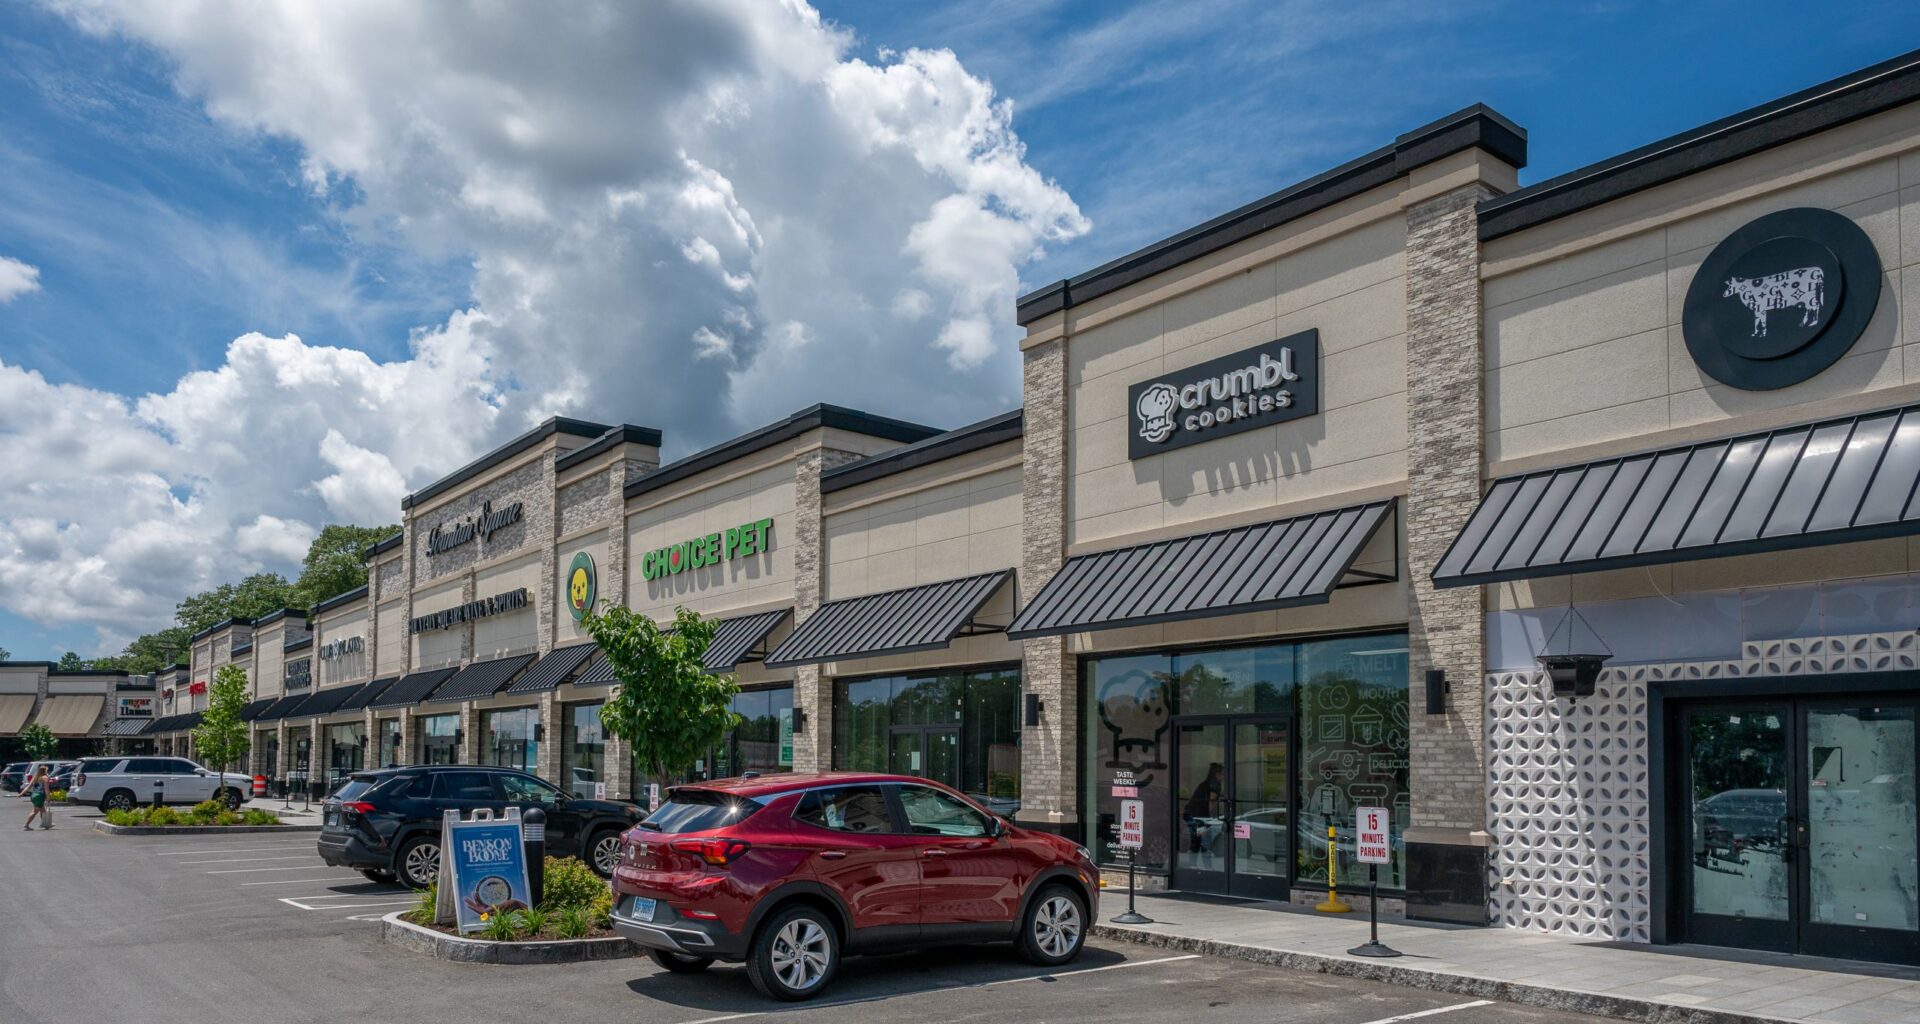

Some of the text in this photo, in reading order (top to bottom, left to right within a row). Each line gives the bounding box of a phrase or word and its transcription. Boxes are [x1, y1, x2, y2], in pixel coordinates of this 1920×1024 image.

[1180, 347, 1298, 409] crumbl
[1185, 390, 1292, 430] cookies
[426, 500, 523, 557] Fountain Square
[642, 518, 773, 581] CHOICE PET
[493, 587, 527, 613] SPIRITS
[1361, 654, 1398, 673] MELT
[1358, 687, 1400, 700] MOUTH
[1128, 805, 1136, 820] 15
[1124, 821, 1140, 831] MINUTE
[1367, 813, 1378, 830] 15
[463, 837, 512, 852] BENSON
[1122, 832, 1141, 843] PARKING
[1361, 833, 1384, 844] MINUTE
[468, 849, 510, 863] BOONE
[1360, 846, 1386, 858] PARKING
